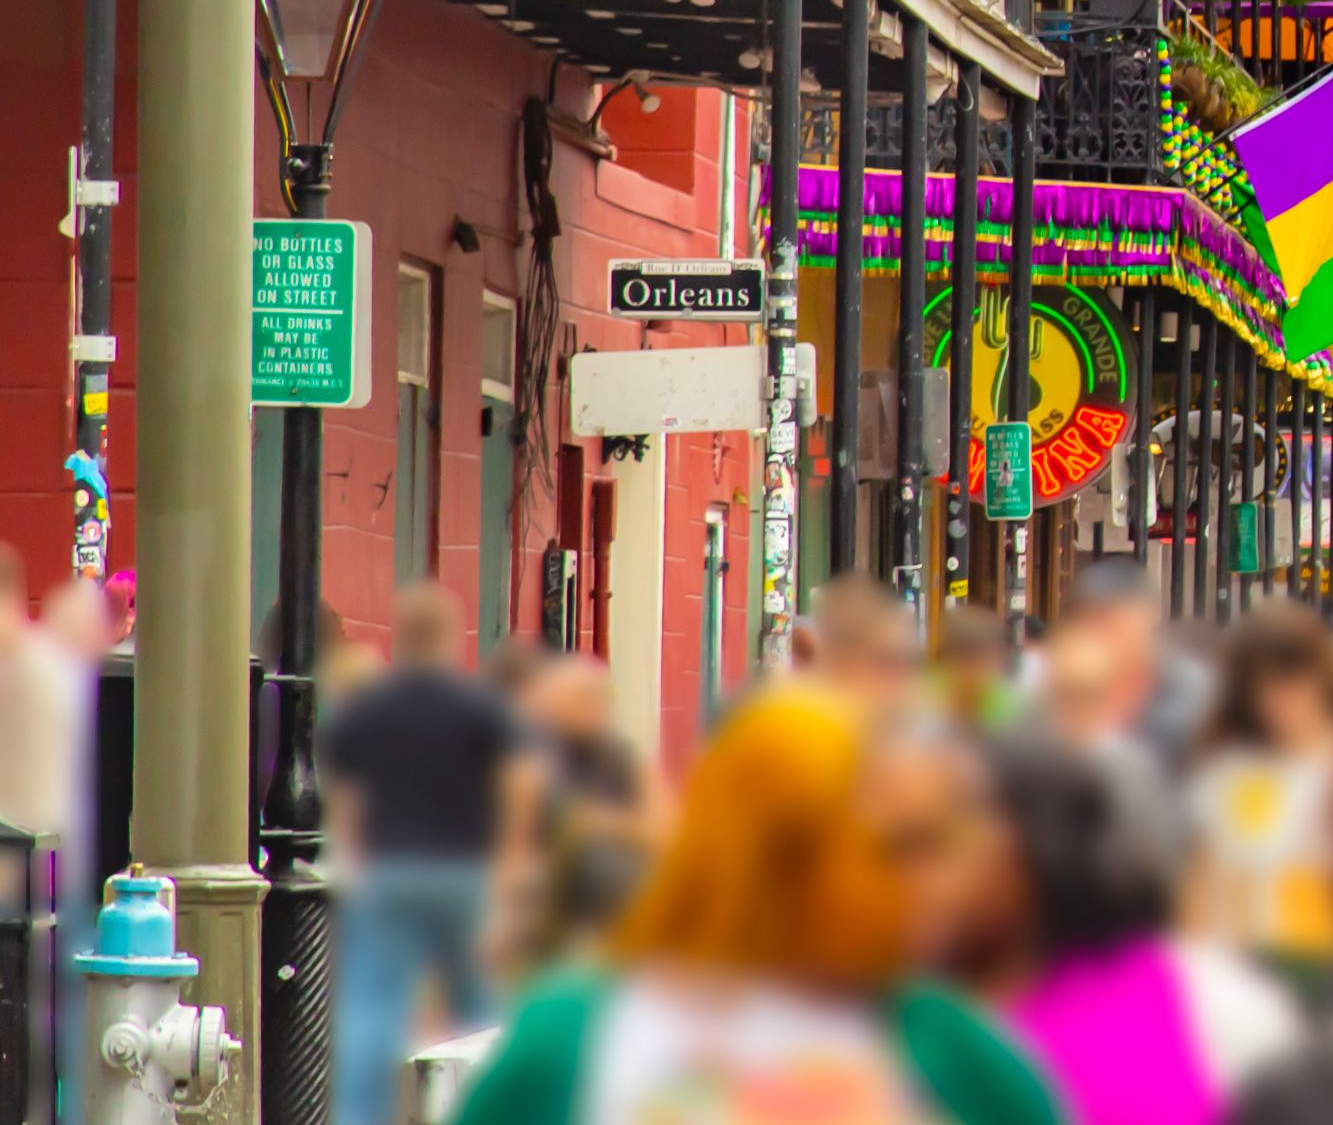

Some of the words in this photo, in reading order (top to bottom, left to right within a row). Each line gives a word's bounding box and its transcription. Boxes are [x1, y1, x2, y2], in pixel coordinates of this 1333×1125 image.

[281, 237, 343, 254] BOTTLES
[262, 254, 281, 270] OR
[288, 255, 334, 271] GLASS
[685, 263, 727, 274] Orleans
[265, 272, 332, 288] ALLOWED
[257, 289, 277, 304] ON
[284, 289, 337, 306] STREET
[623, 278, 750, 307] Orleans
[262, 316, 282, 330] ALL
[287, 317, 332, 331] DRINKS
[274, 331, 299, 345] MAY
[304, 332, 318, 345] BE
[1063, 297, 1118, 383] GRANDE
[263, 346, 275, 359] IN
[281, 346, 329, 361] PLASTIC
[258, 361, 333, 376] CONTAINERS
